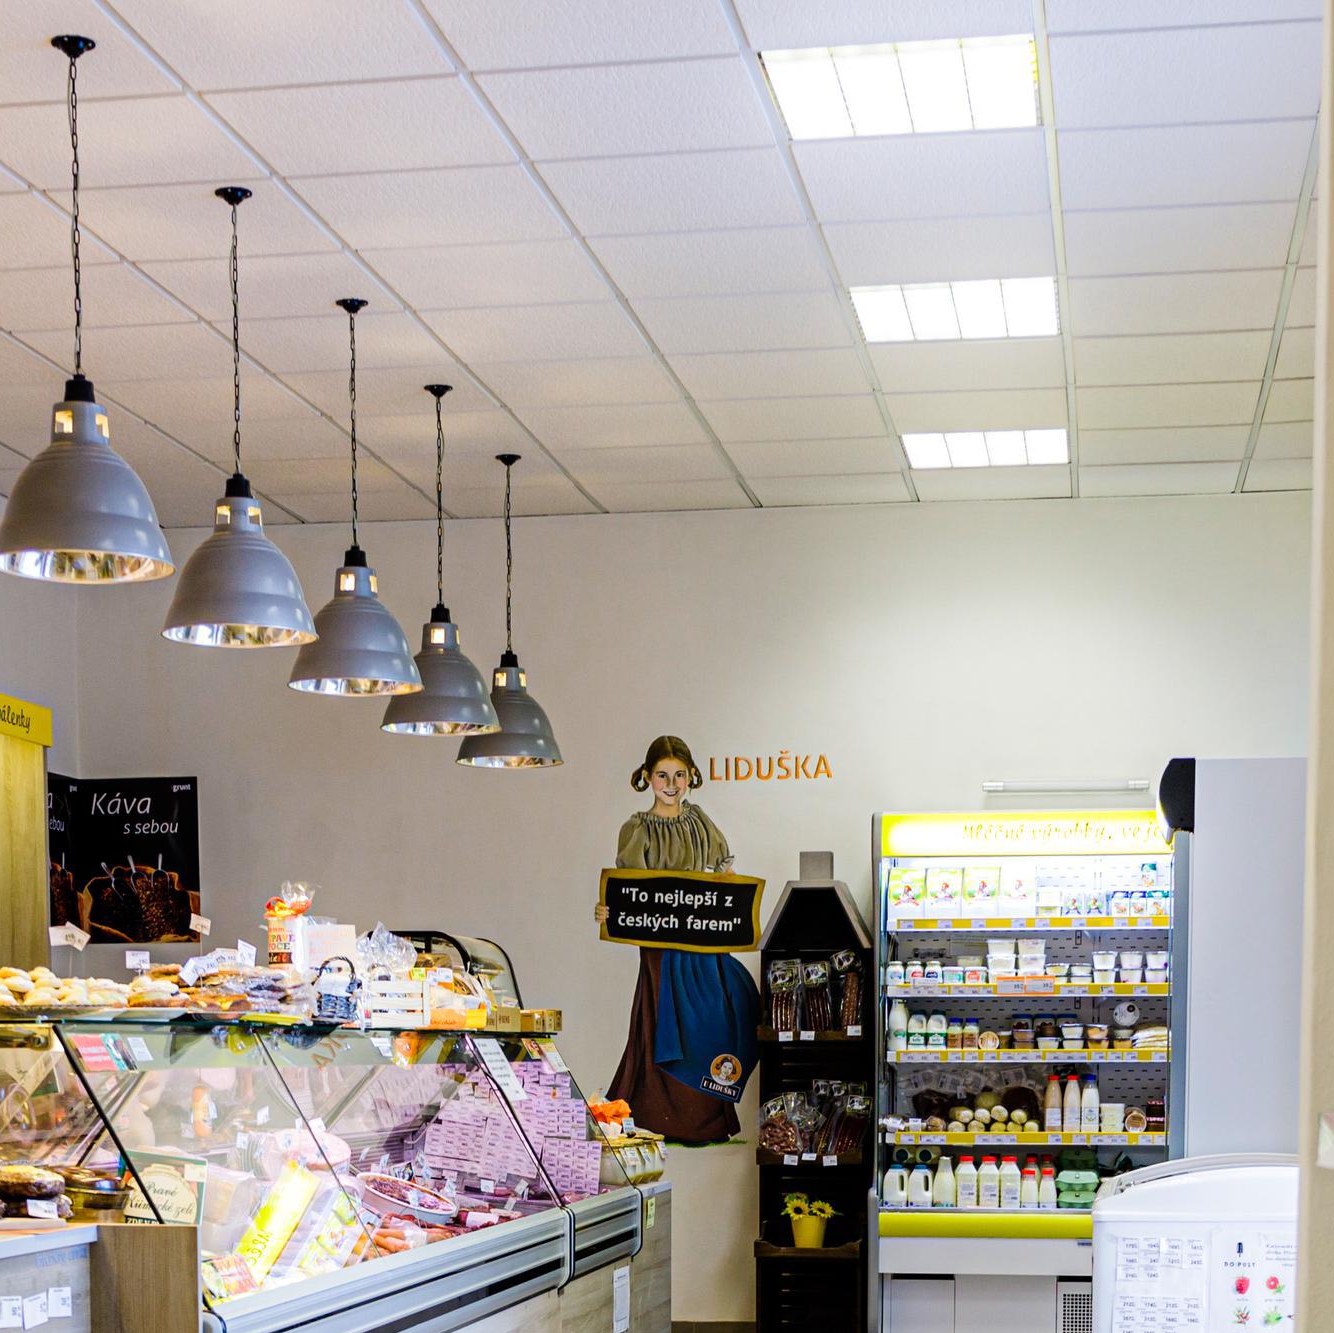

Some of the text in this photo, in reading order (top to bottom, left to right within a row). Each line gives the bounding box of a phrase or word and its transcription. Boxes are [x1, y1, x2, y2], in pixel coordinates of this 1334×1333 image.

[709, 750, 833, 782] LIDUŠKA
[171, 783, 192, 793] grunt
[90, 791, 153, 816] Káva
[123, 818, 180, 835] s sebou
[621, 887, 734, 910] "To nejlepší z
[617, 911, 742, 933] českých farem"
[709, 1081, 737, 1098] LIDUŠKY
